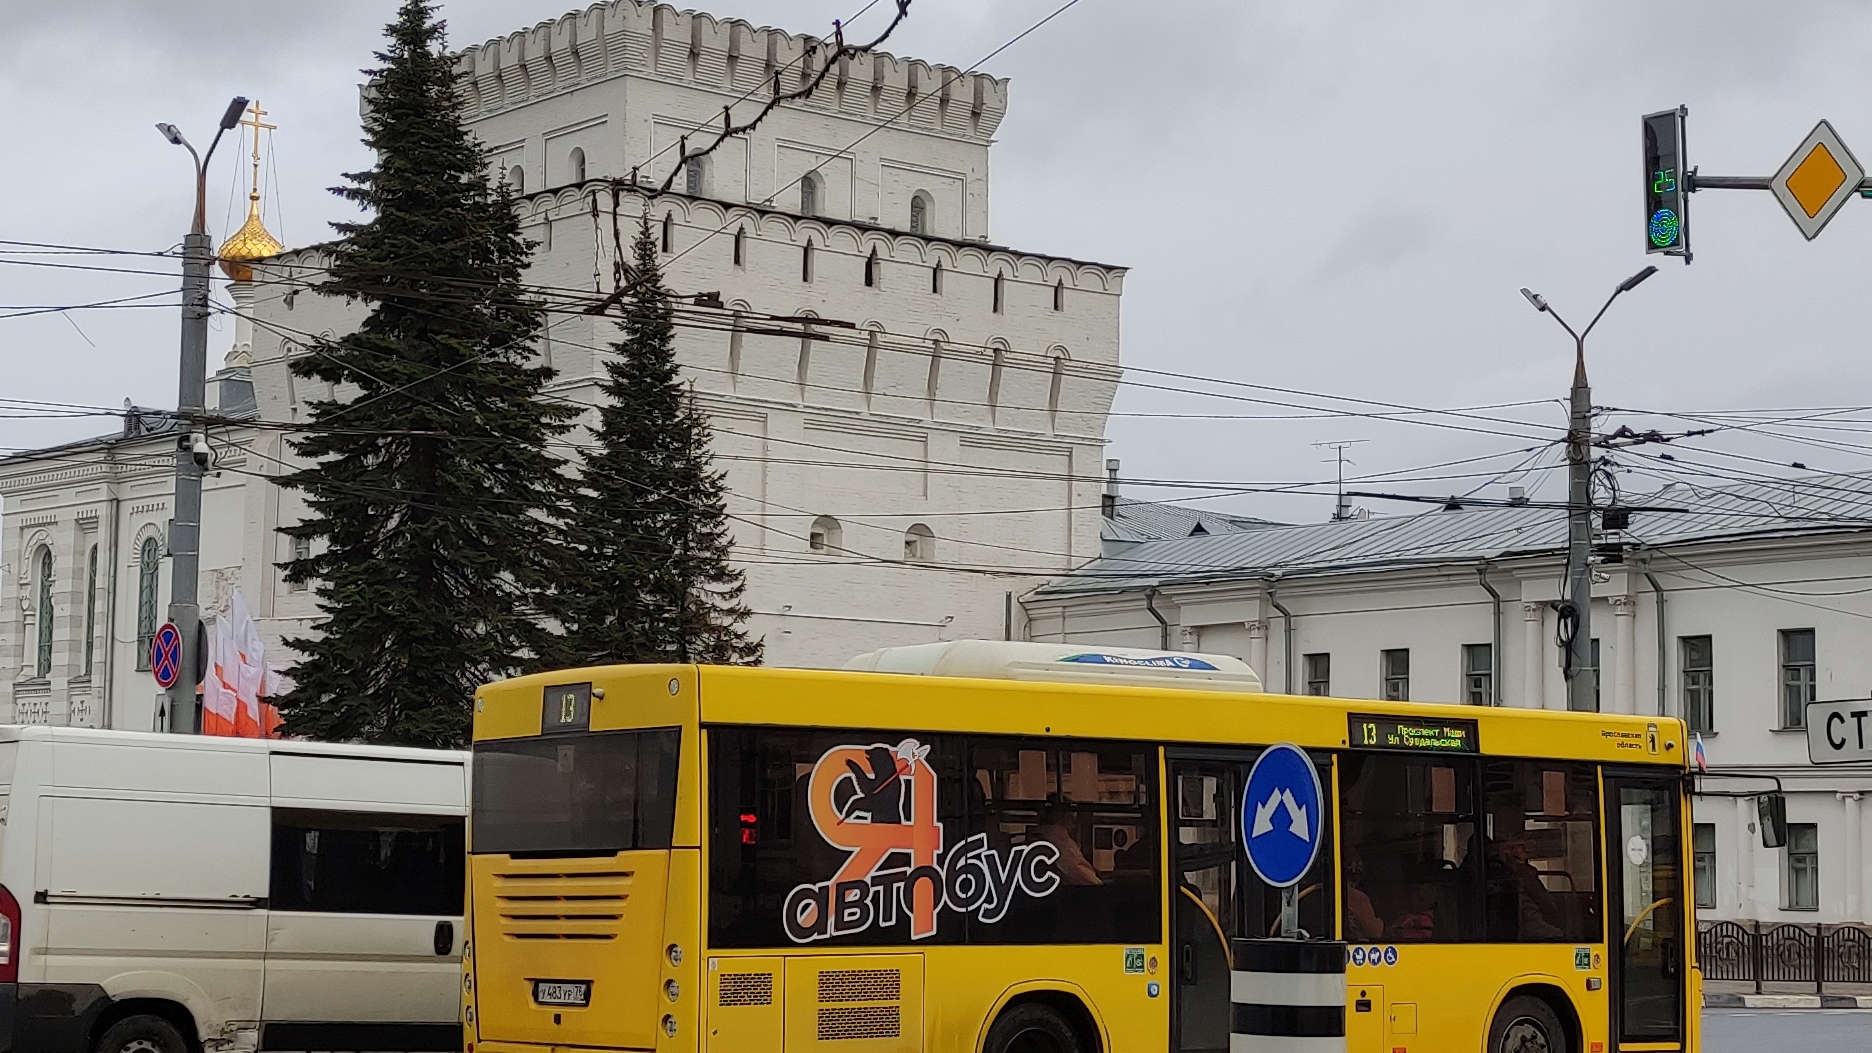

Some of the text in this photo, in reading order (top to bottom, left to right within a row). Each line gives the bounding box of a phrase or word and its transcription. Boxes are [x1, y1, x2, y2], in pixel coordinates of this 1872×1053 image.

[1654, 169, 1676, 193] 25
[560, 693, 575, 723] 13
[1363, 723, 1377, 745] 13
[1387, 733, 1400, 745] Ул
[1397, 725, 1440, 737] Проспект
[783, 833, 1060, 943] автобус
